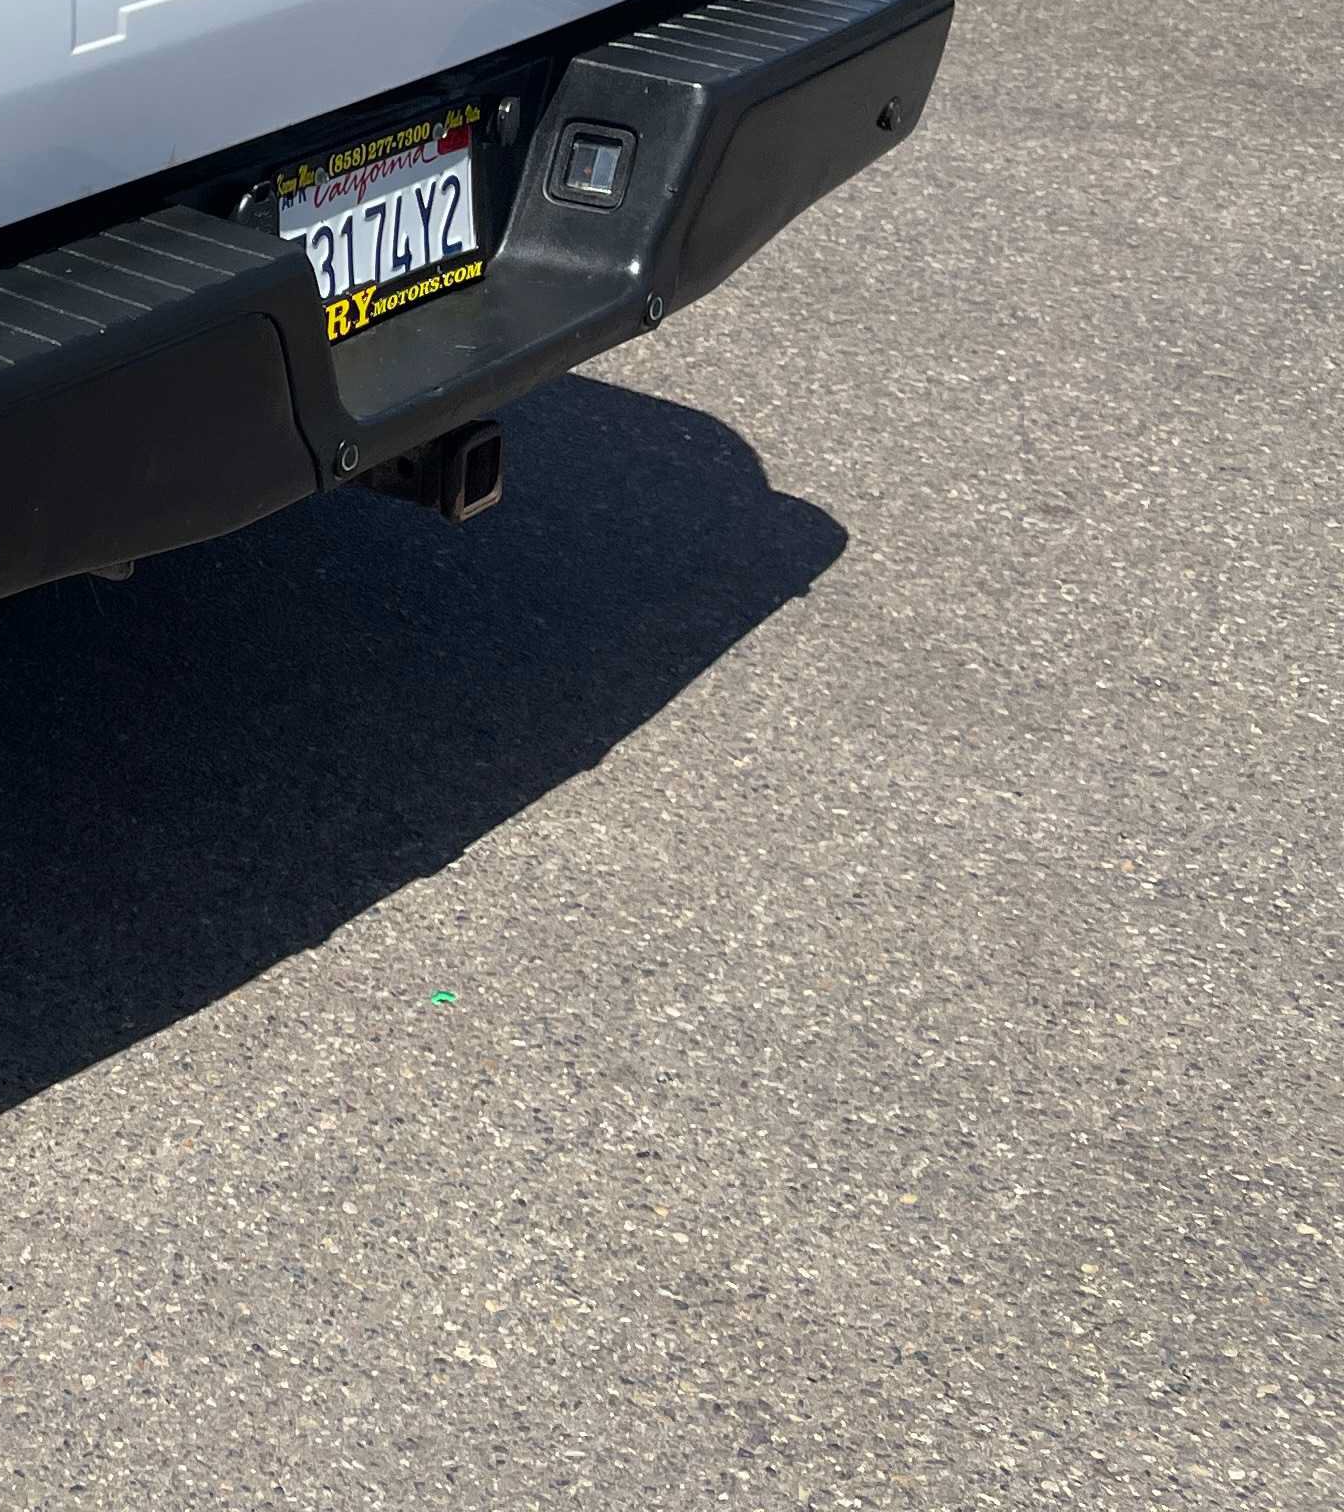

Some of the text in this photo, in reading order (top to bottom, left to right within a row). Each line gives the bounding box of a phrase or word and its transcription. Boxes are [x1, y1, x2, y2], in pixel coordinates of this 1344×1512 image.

[313, 145, 438, 209] California
[328, 122, 432, 176] (858) 277-7300
